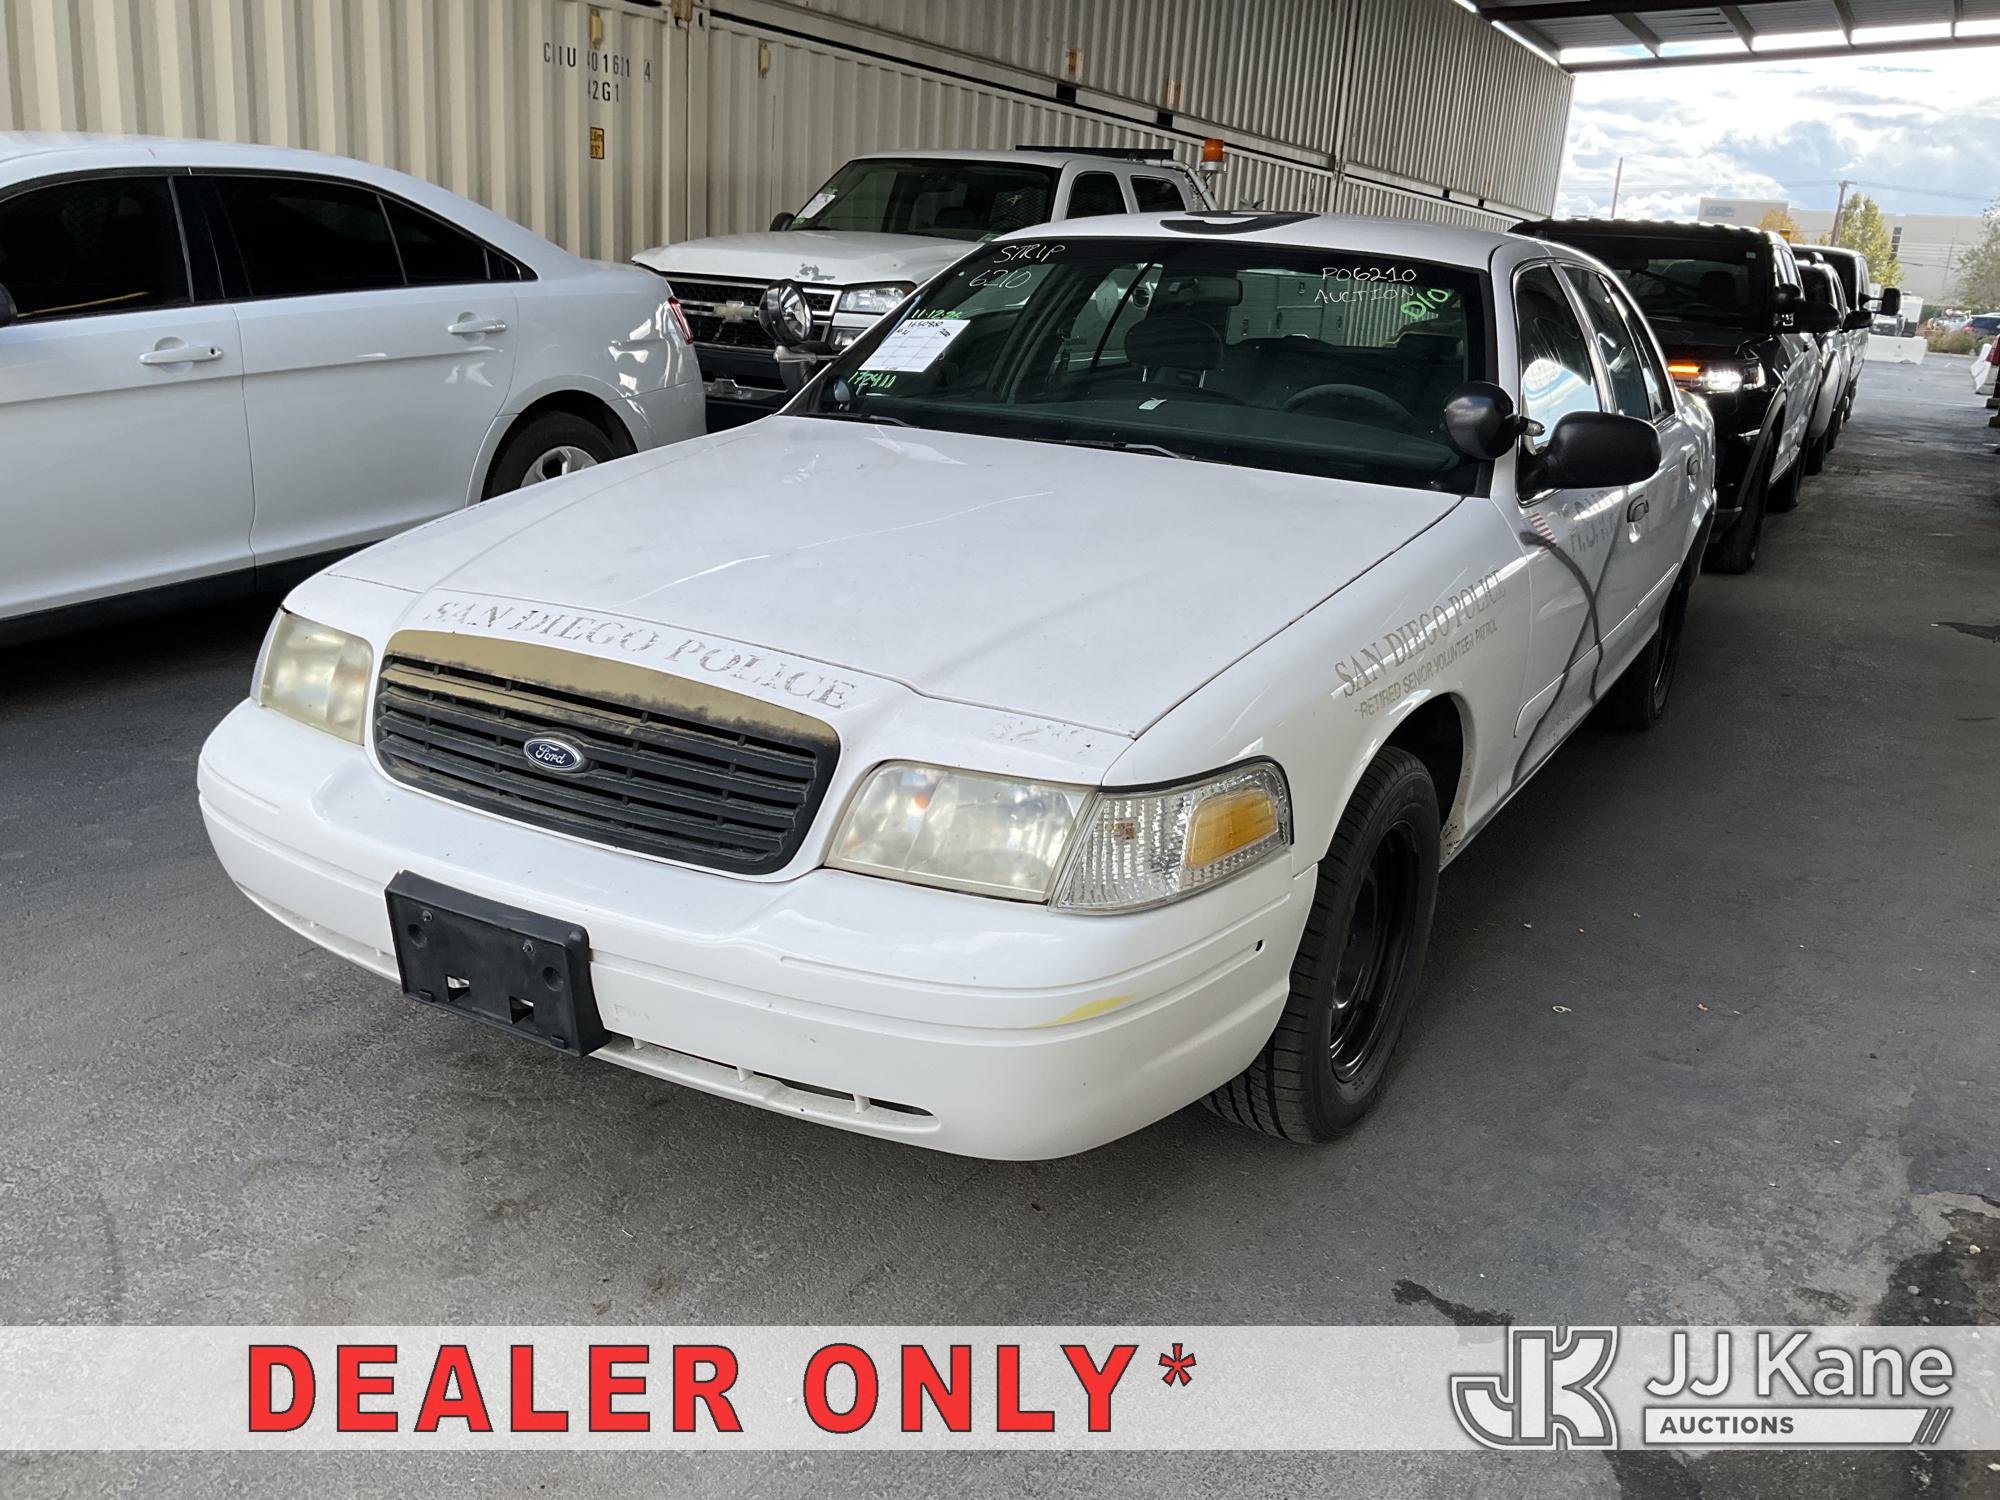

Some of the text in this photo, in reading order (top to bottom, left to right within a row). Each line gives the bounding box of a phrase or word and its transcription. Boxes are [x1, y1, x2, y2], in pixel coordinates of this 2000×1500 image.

[993, 244, 1066, 264] STRIP
[1314, 286, 1414, 304] AUCTION
[506, 610, 660, 651] DIEGO
[664, 638, 856, 709] POLICE
[1334, 642, 1387, 698] SAN
[1382, 605, 1450, 668] DIEGO
[1359, 685, 1401, 719] RETIRED
[535, 744, 567, 764] Ford
